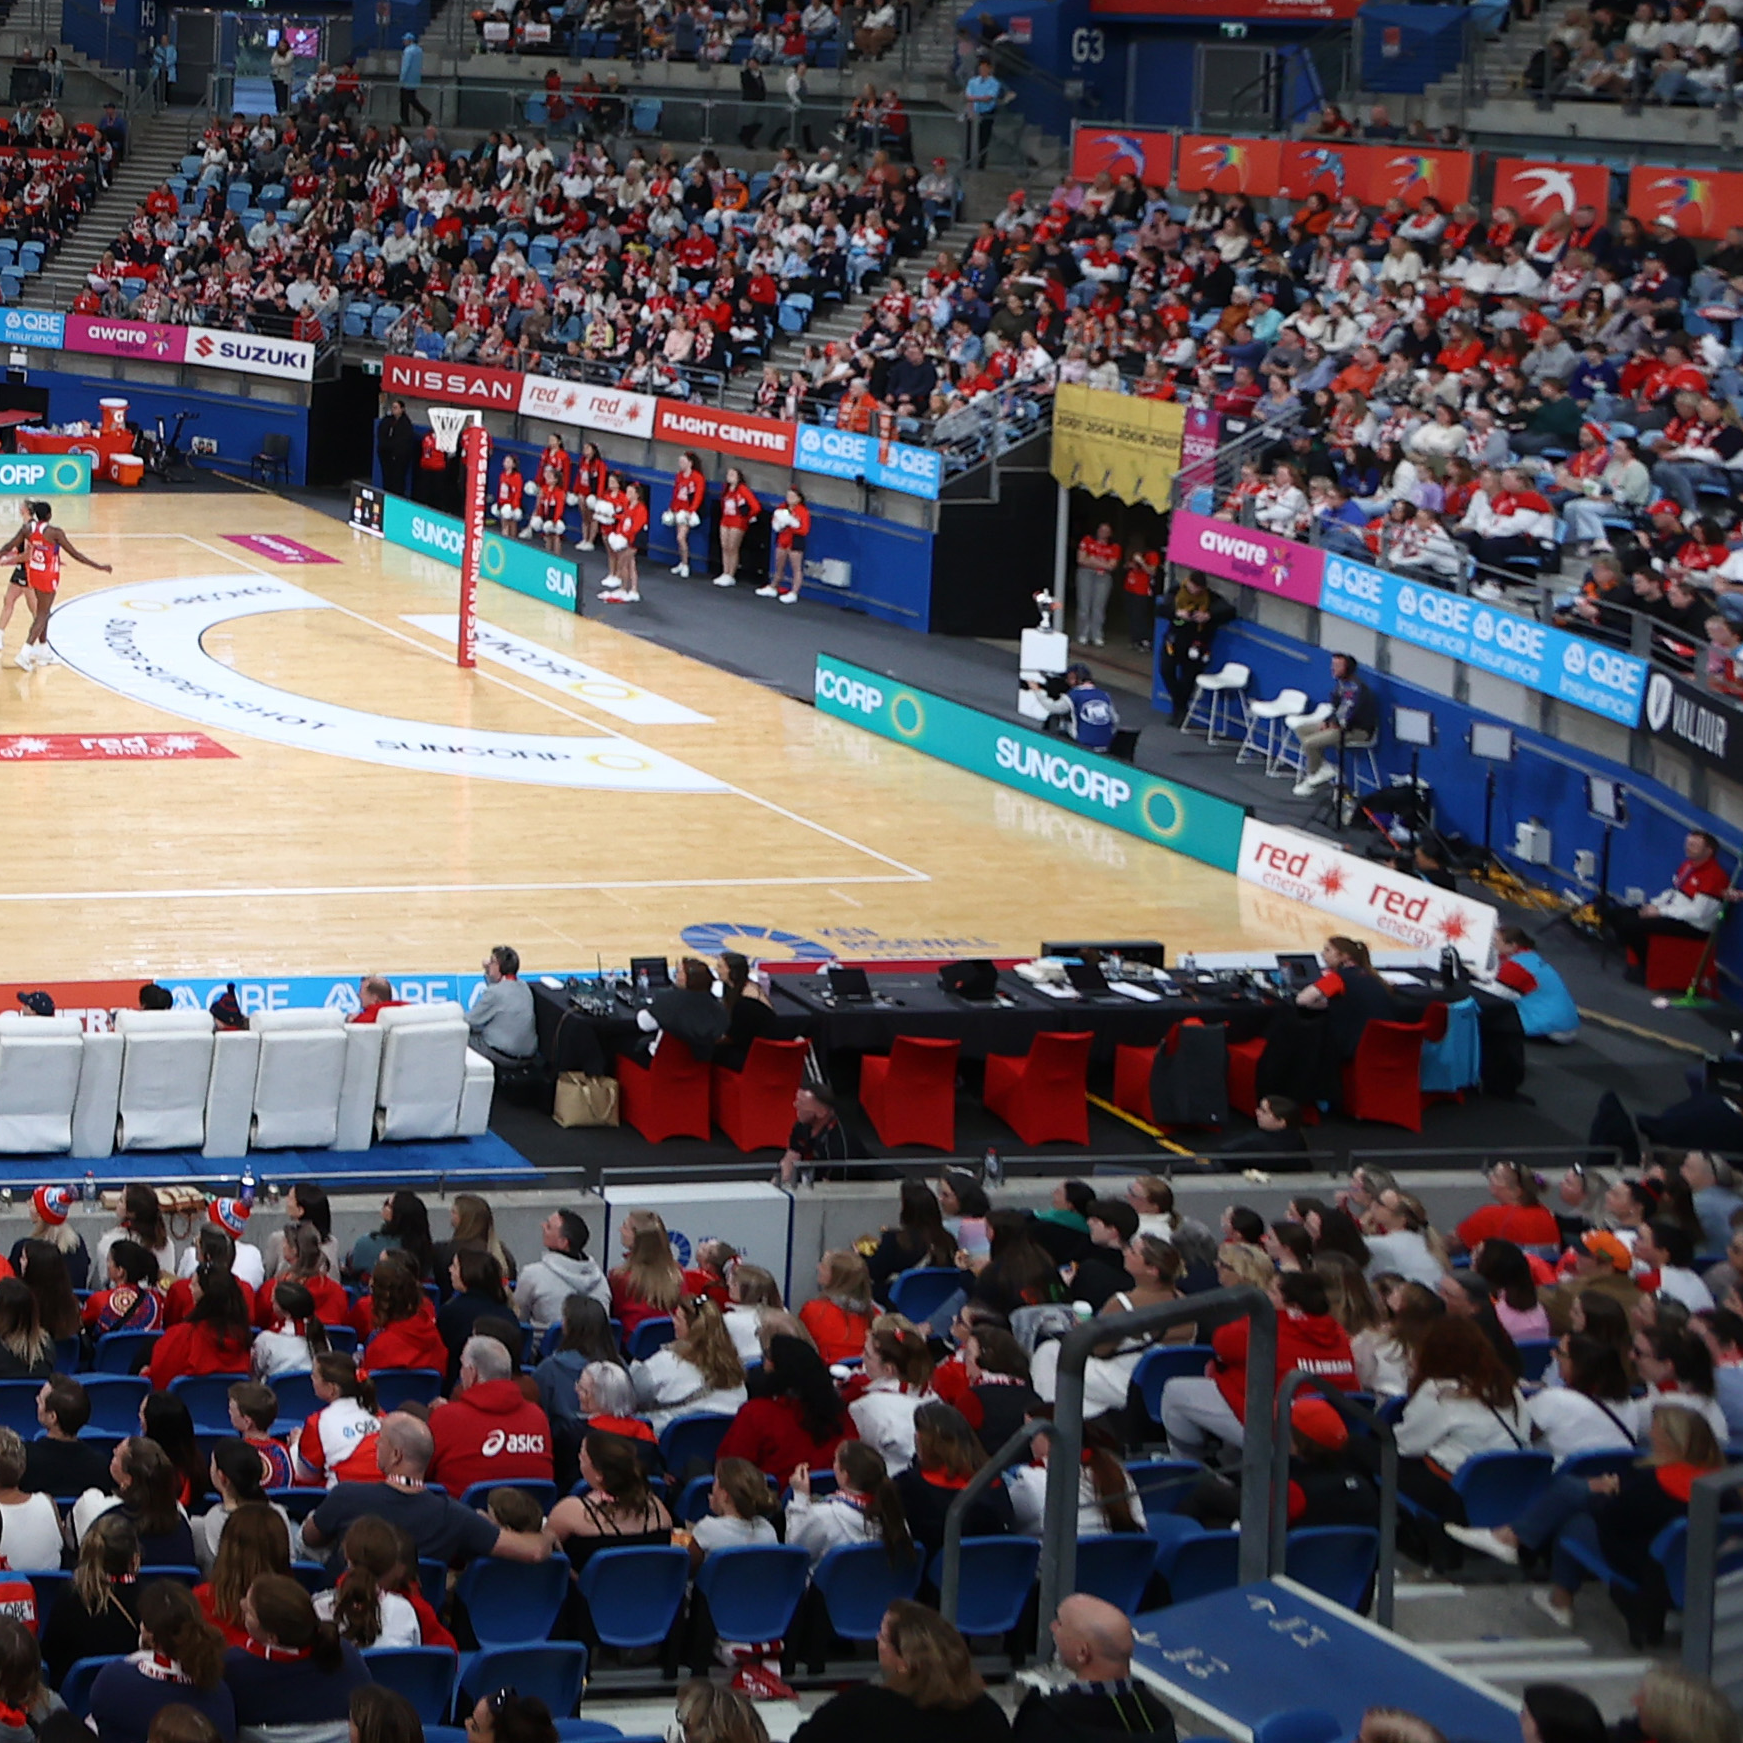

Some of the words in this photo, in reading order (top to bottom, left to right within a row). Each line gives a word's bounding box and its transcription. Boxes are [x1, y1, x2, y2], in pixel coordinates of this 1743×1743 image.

[141, 0, 155, 26] H3
[1071, 28, 1104, 63] G3
[23, 316, 60, 334] QBE
[88, 325, 147, 345] aware
[220, 342, 306, 369] SUZUKI
[392, 367, 513, 401] NISSAN
[529, 385, 559, 404] red
[589, 396, 620, 415] red
[662, 412, 718, 437] FLIGHT
[719, 425, 787, 452] CENTRE
[823, 433, 868, 463] QBE
[477, 431, 488, 504] NISSAN
[900, 451, 935, 478] QBE
[470, 511, 485, 583] NISSAN
[1200, 530, 1267, 567] aware
[1344, 565, 1383, 605] QBE
[466, 588, 477, 661] NISSAN
[1420, 592, 1471, 633] QBE
[1496, 618, 1546, 661] QBE
[1588, 651, 1641, 696] QBE
[79, 736, 145, 749] red
[375, 739, 572, 761] SUNCORP
[995, 736, 1131, 809] SUNCORP
[1254, 842, 1310, 877] red
[1262, 870, 1317, 903] energy
[1369, 884, 1429, 922] red
[1377, 914, 1433, 950] energy
[506, 1433, 544, 1453] asics
